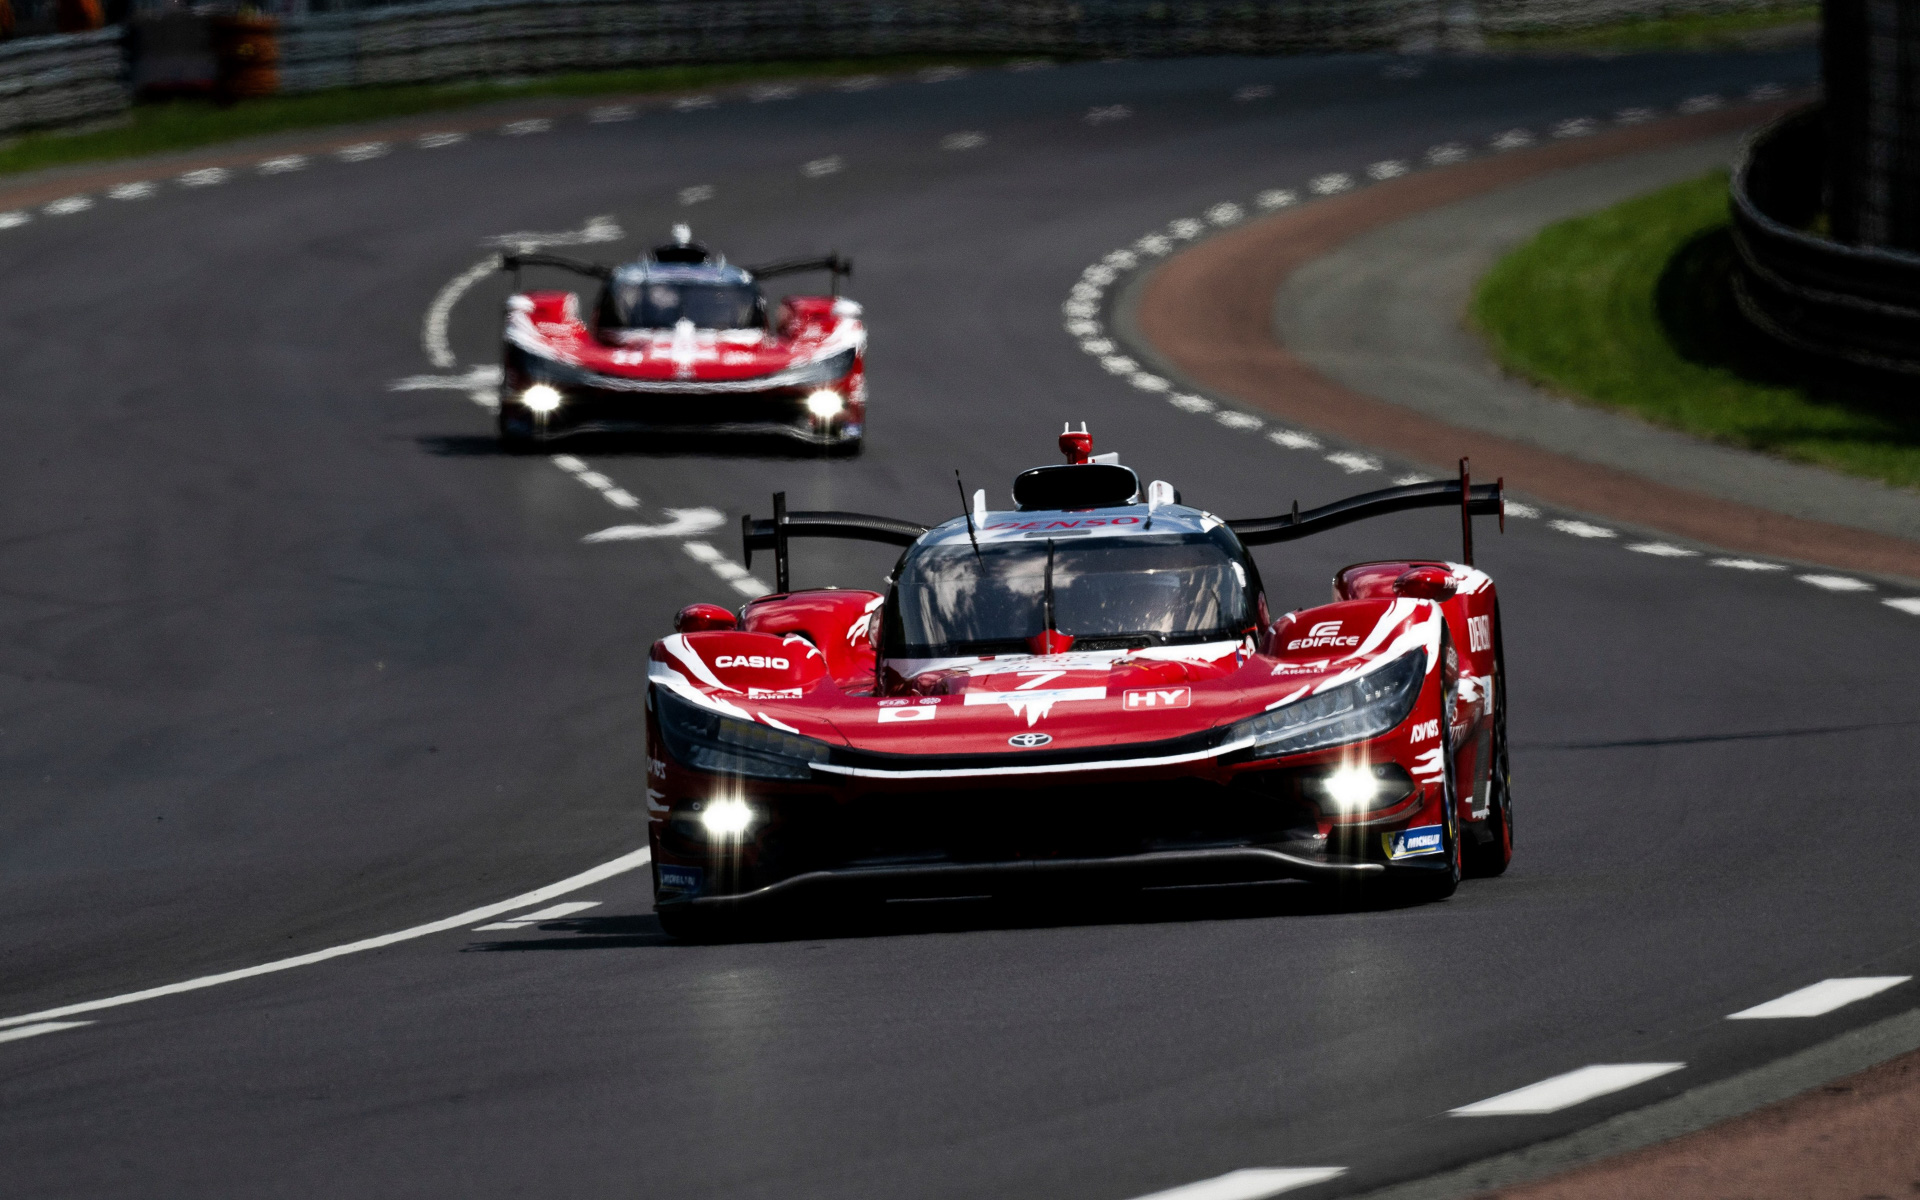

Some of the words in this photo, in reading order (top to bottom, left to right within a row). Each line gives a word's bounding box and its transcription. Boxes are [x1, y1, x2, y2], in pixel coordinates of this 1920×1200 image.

[985, 516, 1140, 531] DENSO
[1467, 615, 1491, 653] DENSO
[1287, 635, 1360, 650] EDIFICE
[715, 655, 790, 670] CASIO
[1014, 670, 1067, 690] 7
[1128, 690, 1185, 706] HY
[1407, 834, 1440, 849] MICHELIN
